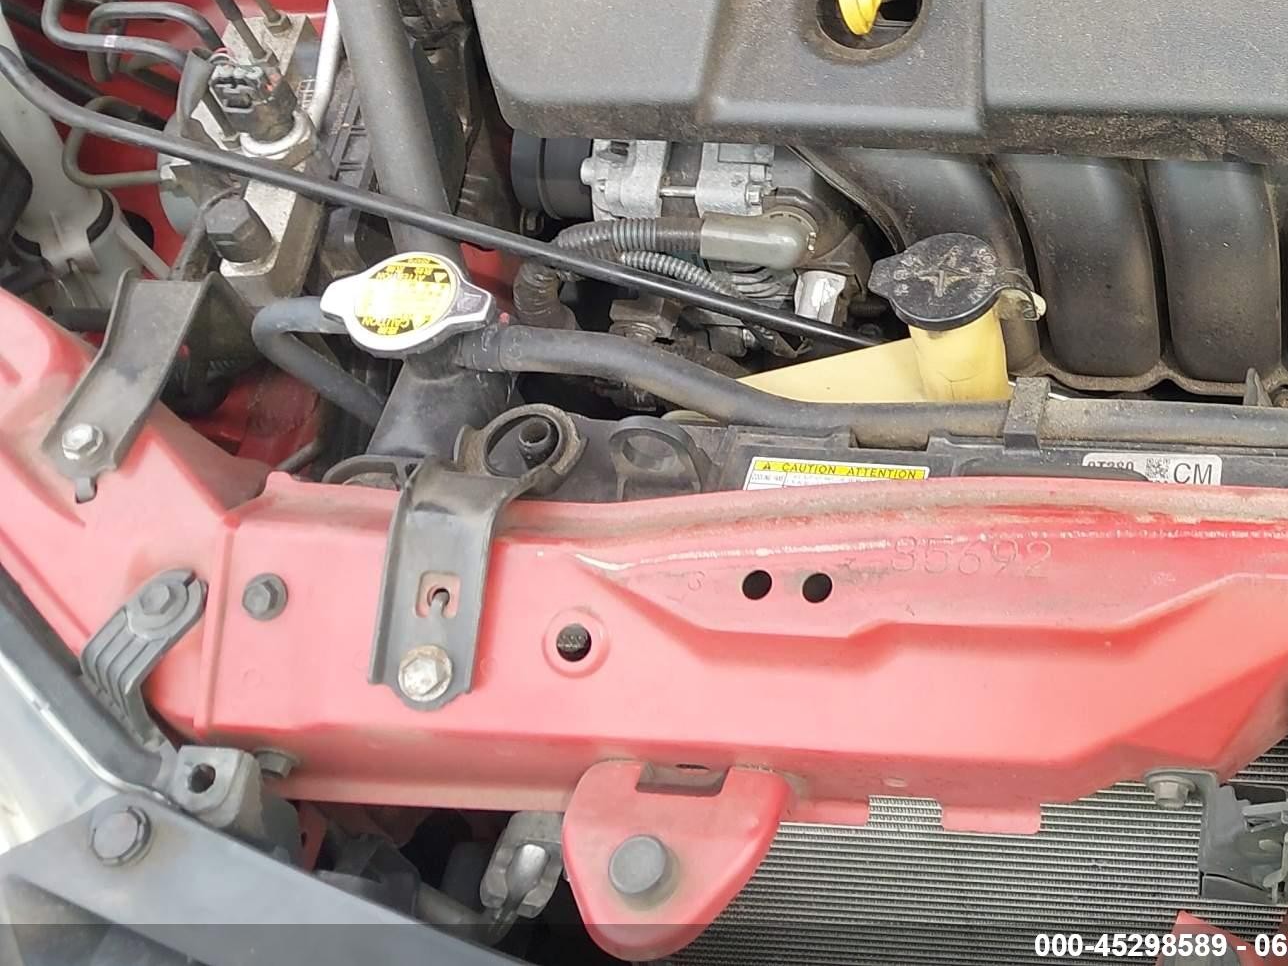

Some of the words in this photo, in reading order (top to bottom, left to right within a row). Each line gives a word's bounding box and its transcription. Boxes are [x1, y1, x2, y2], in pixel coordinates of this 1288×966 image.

[361, 317, 410, 328] CAUTION
[781, 461, 837, 475] CAUTION
[848, 467, 917, 480] ATTENTION
[1174, 462, 1213, 485] CM
